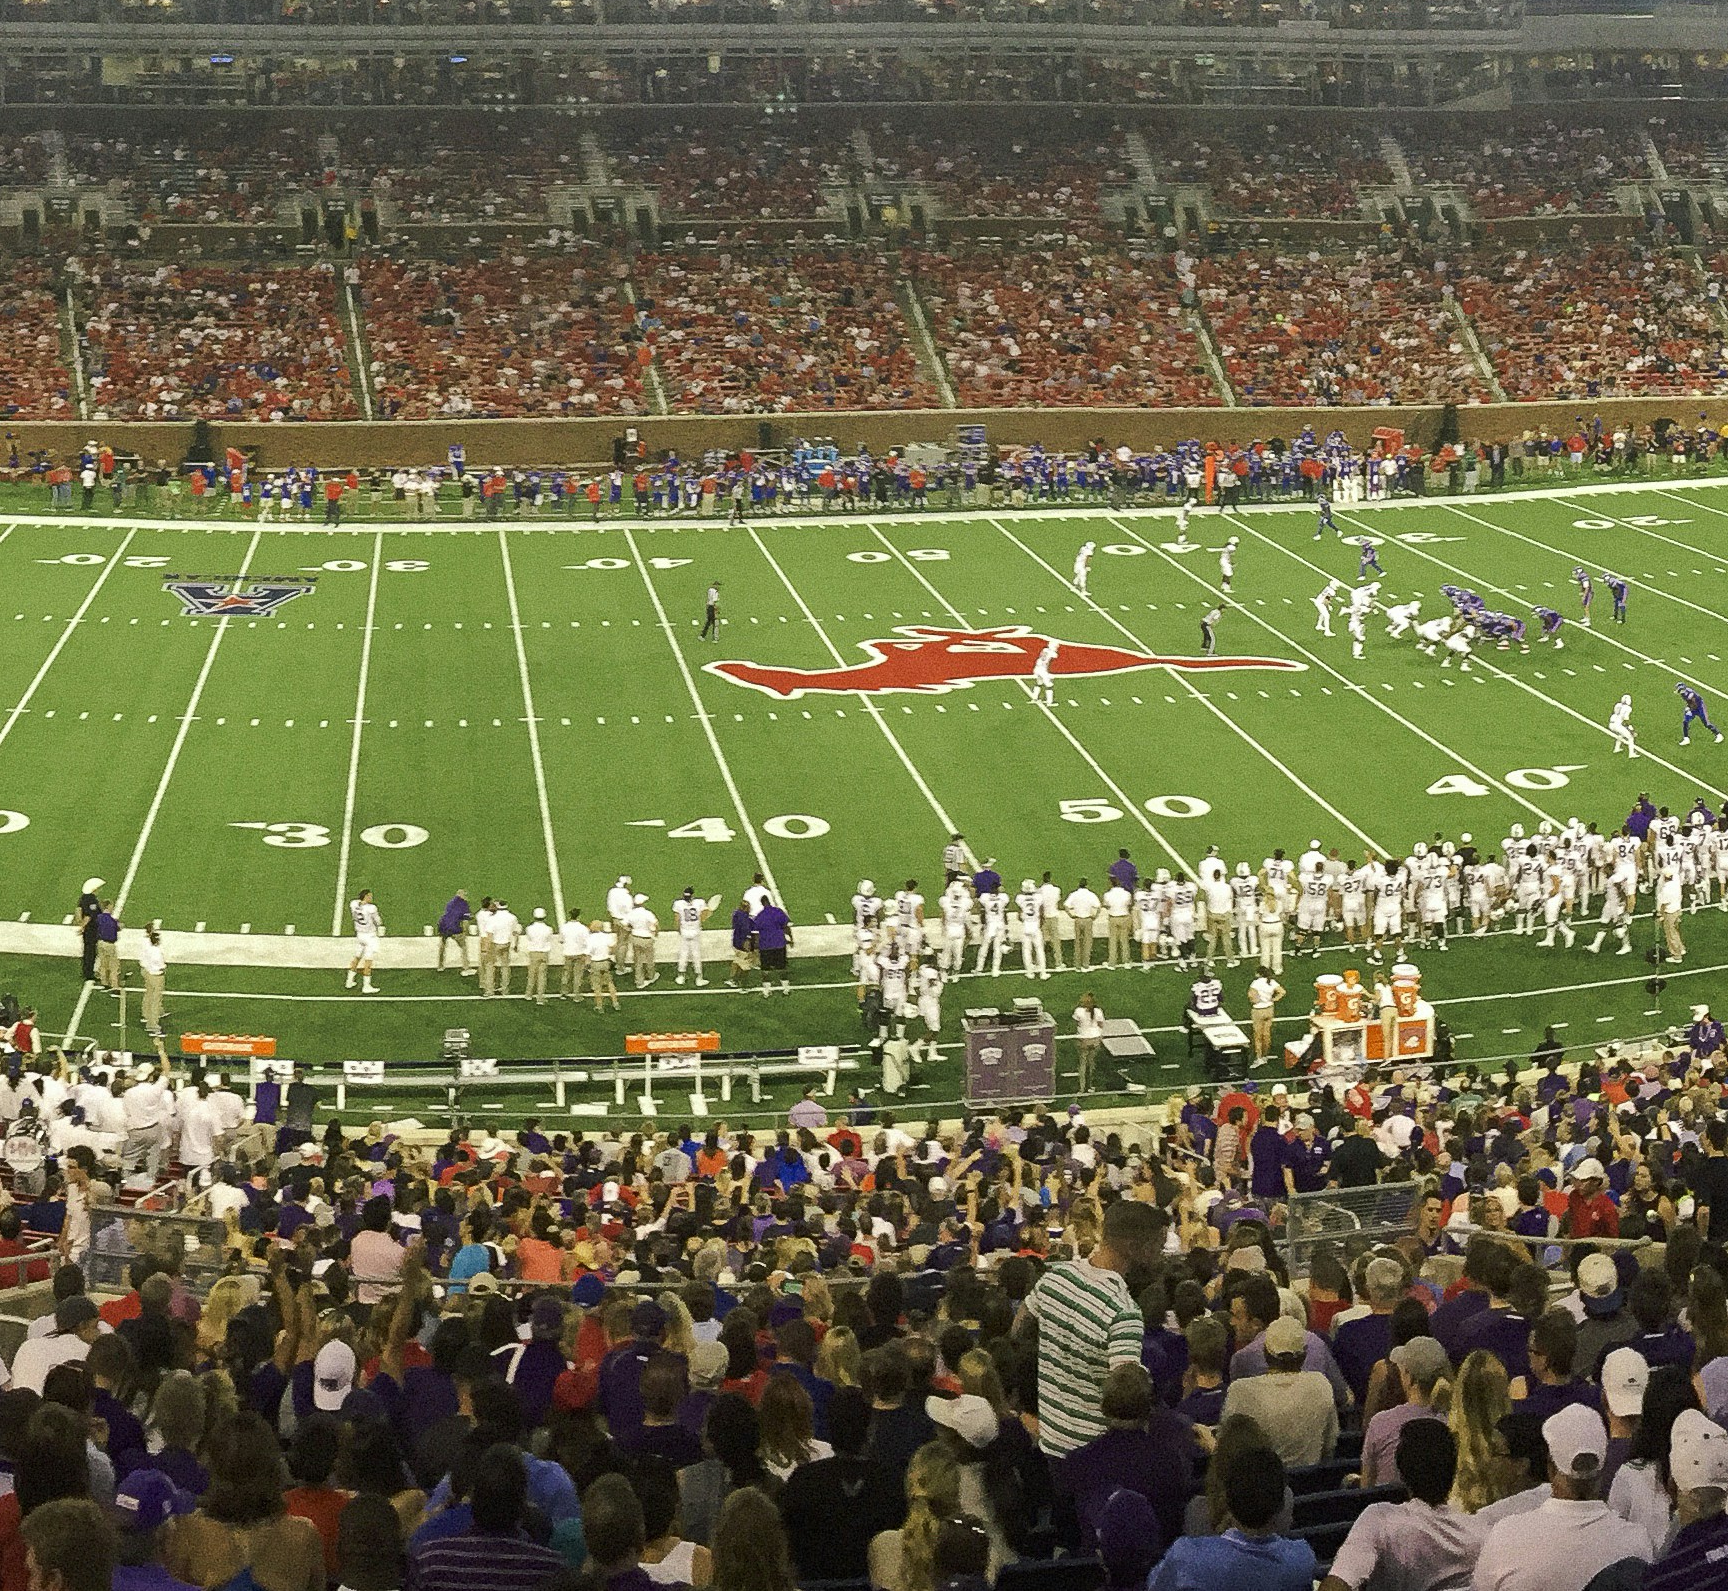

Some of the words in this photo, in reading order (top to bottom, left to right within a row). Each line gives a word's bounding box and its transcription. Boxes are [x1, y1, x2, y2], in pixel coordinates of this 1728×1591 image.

[1572, 514, 1675, 530] 20
[846, 549, 952, 563] 50
[1101, 542, 1205, 556] 40
[60, 553, 171, 568] 20
[321, 559, 431, 572] 30
[583, 557, 696, 570] 40
[1425, 767, 1572, 797] 40
[1058, 795, 1212, 824] 50
[667, 813, 831, 843] 40
[261, 822, 430, 849] 30
[1618, 844, 1635, 858] 84
[1666, 852, 1679, 865] 14
